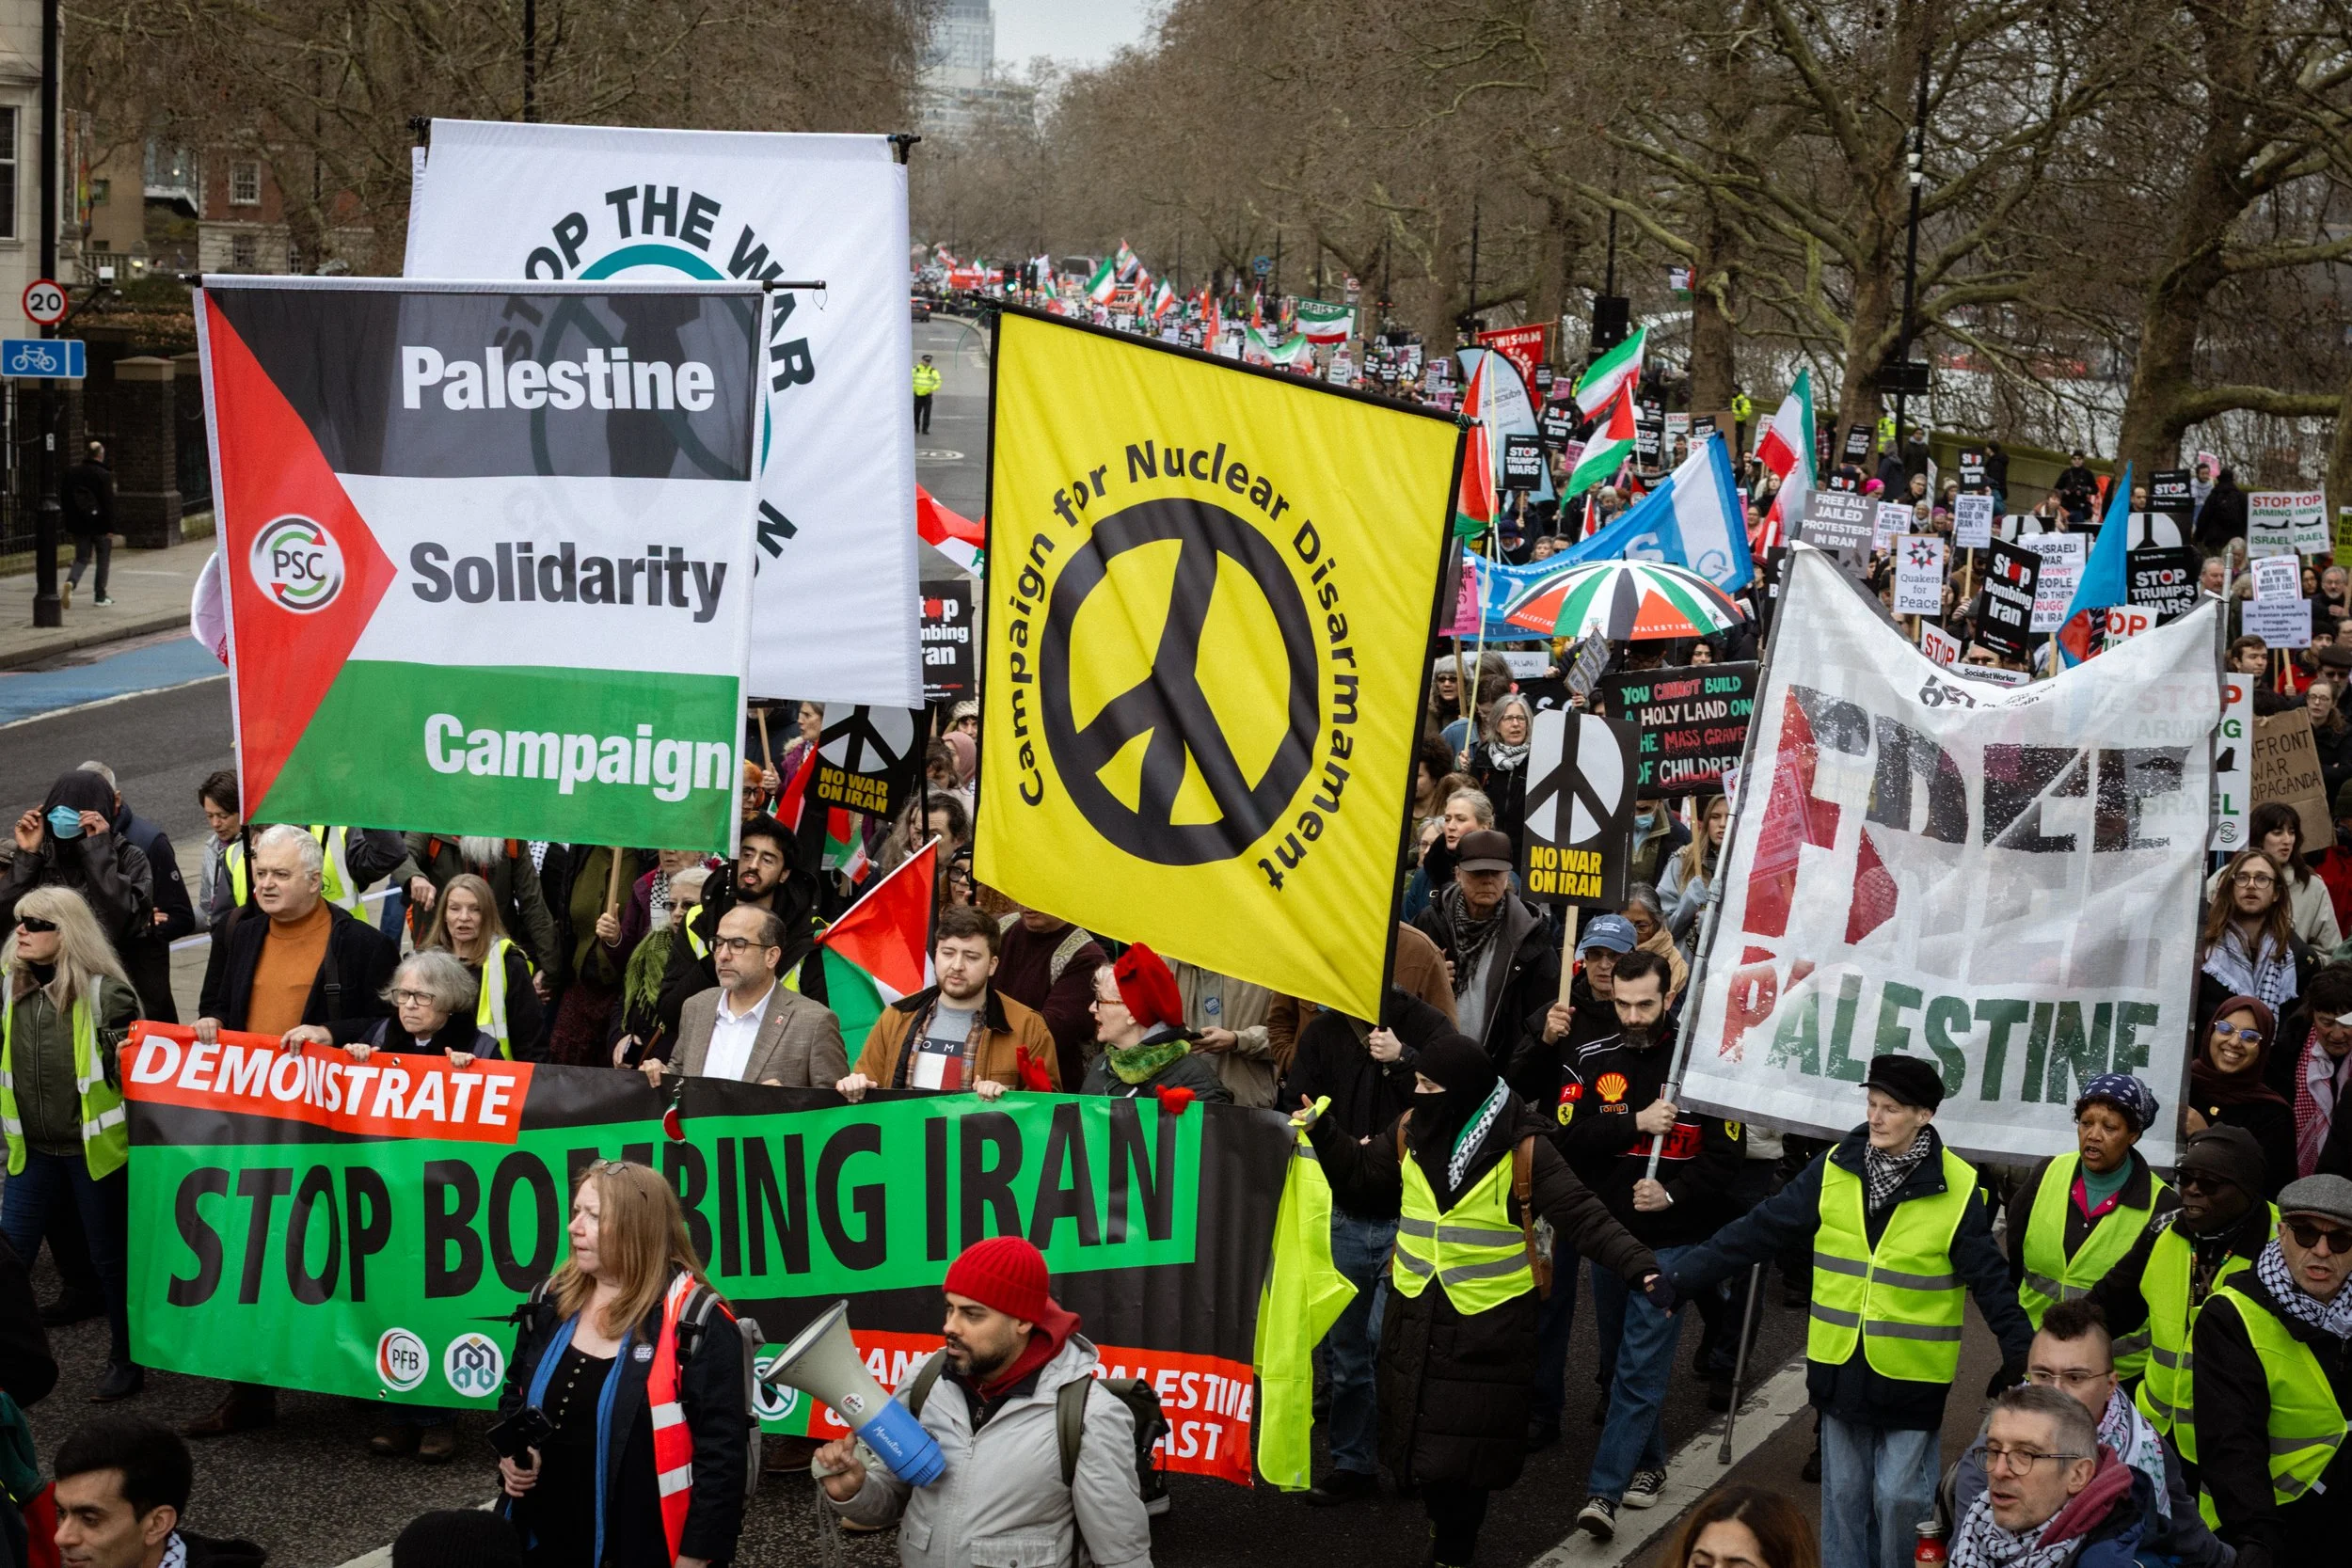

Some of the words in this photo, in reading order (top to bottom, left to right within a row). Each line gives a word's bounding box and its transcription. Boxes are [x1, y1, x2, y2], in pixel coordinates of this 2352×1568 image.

[605, 184, 722, 252] THE
[727, 224, 816, 393] WAR
[30, 293, 61, 310] 20
[1481, 331, 1541, 347] LWISHAM
[402, 346, 717, 412] Palestine
[1549, 407, 1570, 421] Stop
[1667, 414, 1689, 422] STOP
[1510, 447, 1539, 457] STOP
[1963, 453, 1981, 465] Stop
[1506, 456, 1541, 466] TRUMP'S
[1507, 465, 1539, 475] WARS
[1964, 473, 1981, 483] Iran
[1831, 476, 1855, 491] Stop
[2154, 483, 2186, 495] STOP
[1815, 494, 1845, 507] FREE
[1847, 498, 1869, 509] ALL
[1958, 501, 1976, 511] STOP
[1978, 503, 1990, 512] THE
[2252, 497, 2292, 508] STOP
[2296, 495, 2322, 507] TOP
[1815, 506, 1863, 522] JAILED
[1958, 511, 1972, 519] WAR
[1975, 512, 1984, 520] ON
[2251, 509, 2292, 517] ARMING
[2296, 506, 2323, 516] MING
[1803, 519, 1872, 536] PROTESTERS
[1957, 519, 1973, 528] IRAN
[1814, 533, 1827, 544] IN
[1828, 535, 1857, 548] IRAN
[2250, 536, 2290, 545] ISRAEL
[273, 550, 324, 581] PSC
[2042, 556, 2063, 565] WAR
[1462, 566, 1473, 579] HE
[1900, 574, 1940, 583] Quakers
[1993, 553, 2032, 588] Stop
[2136, 569, 2186, 587] STOP
[410, 541, 727, 623] Solidarity
[1913, 585, 1927, 594] for
[2039, 578, 2073, 588] EOPLE
[1985, 577, 2033, 610] Bombing
[2131, 585, 2195, 600] TRUMP'S
[918, 594, 959, 622] top
[1899, 595, 1938, 609] Peace
[1989, 595, 2022, 626] Iran
[2035, 601, 2064, 611] RUGG
[1515, 611, 1555, 626] PALESTINE
[2034, 613, 2044, 622] IN
[2048, 613, 2063, 622] IRA
[2106, 612, 2148, 637] OP
[921, 624, 968, 643] mbing
[1633, 624, 1693, 633] PALESTINE
[921, 646, 956, 665] an
[1925, 633, 1955, 667] STOP
[1009, 531, 1056, 807] Campaign
[1053, 464, 1109, 529] for
[1125, 439, 1290, 522] Nuclear
[1257, 518, 1359, 893] Disarmament
[1964, 668, 1993, 680] Socialist
[1993, 673, 2017, 683] Worker
[1621, 686, 1650, 705] YOU
[1654, 678, 1701, 701] CANNOT
[1705, 676, 1741, 694] BUILD
[1626, 710, 1634, 721] A
[1641, 704, 1679, 726] HOLY
[1684, 700, 1727, 721] LAND
[1730, 699, 1754, 716] ON
[1640, 734, 1659, 752] HE
[1664, 729, 1701, 751] MASS
[2252, 729, 2309, 762] NFRONT
[424, 713, 731, 801] Campaign
[1638, 760, 1654, 784] OF
[2252, 758, 2289, 779] WAR
[819, 767, 845, 784] NO
[849, 775, 888, 798] WAR
[2250, 771, 2321, 801] OPAGANDA
[818, 782, 842, 802] ON
[844, 789, 888, 814] IRAN
[1531, 846, 1557, 870] NO
[1561, 850, 1602, 871] WAR
[1529, 869, 1557, 894] ON
[1559, 871, 1602, 898] IRAN
[1718, 958, 2160, 1106] PALESTINE
[129, 1035, 516, 1126] DEMONSTRATE
[166, 1164, 392, 1307] STOP
[423, 1122, 887, 1300] BOBING
[925, 1097, 1172, 1261] IRAN
[392, 1349, 419, 1370] PFB
[873, 1425, 904, 1457] Manutan
[1152, 1418, 1222, 1461] AST
